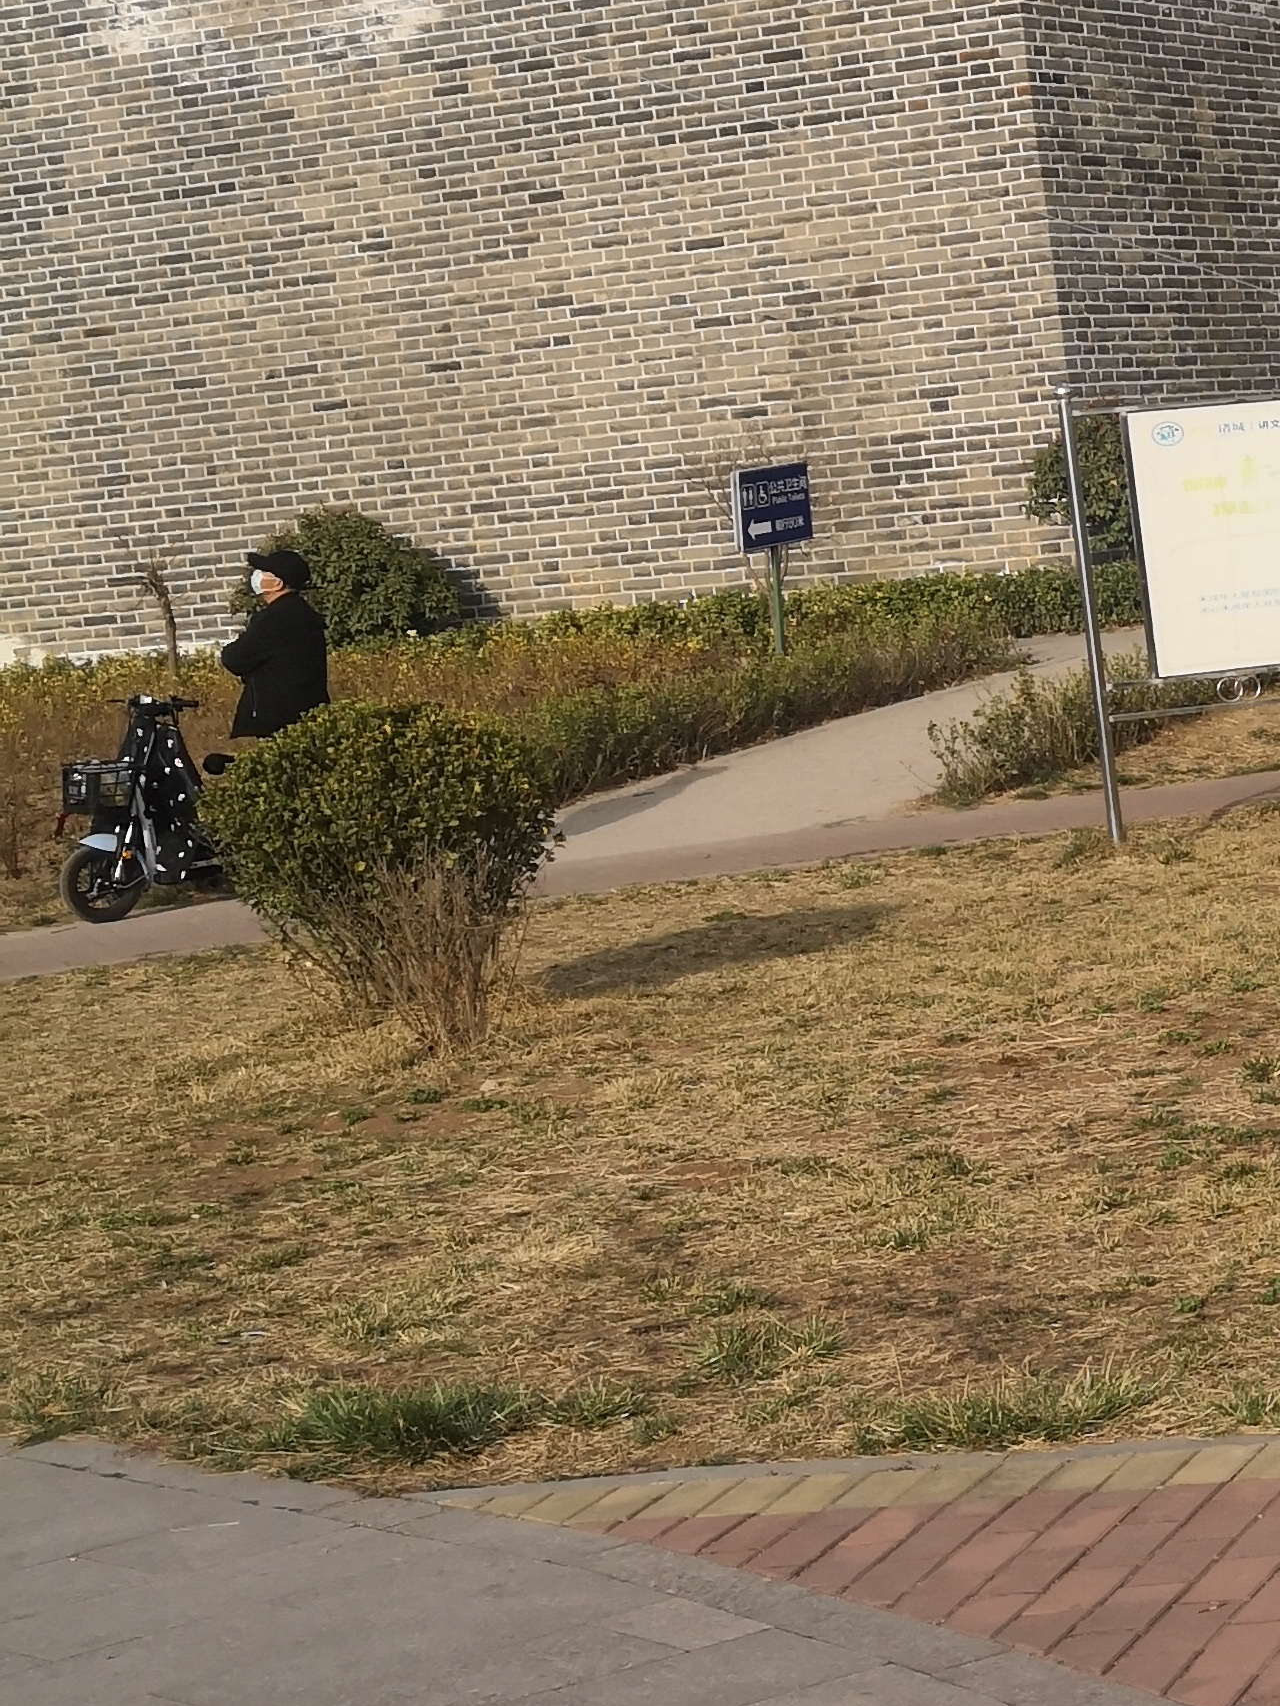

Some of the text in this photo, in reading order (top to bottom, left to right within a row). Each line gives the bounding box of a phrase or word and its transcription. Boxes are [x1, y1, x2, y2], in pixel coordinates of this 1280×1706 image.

[770, 475, 807, 494] 公共卫生间
